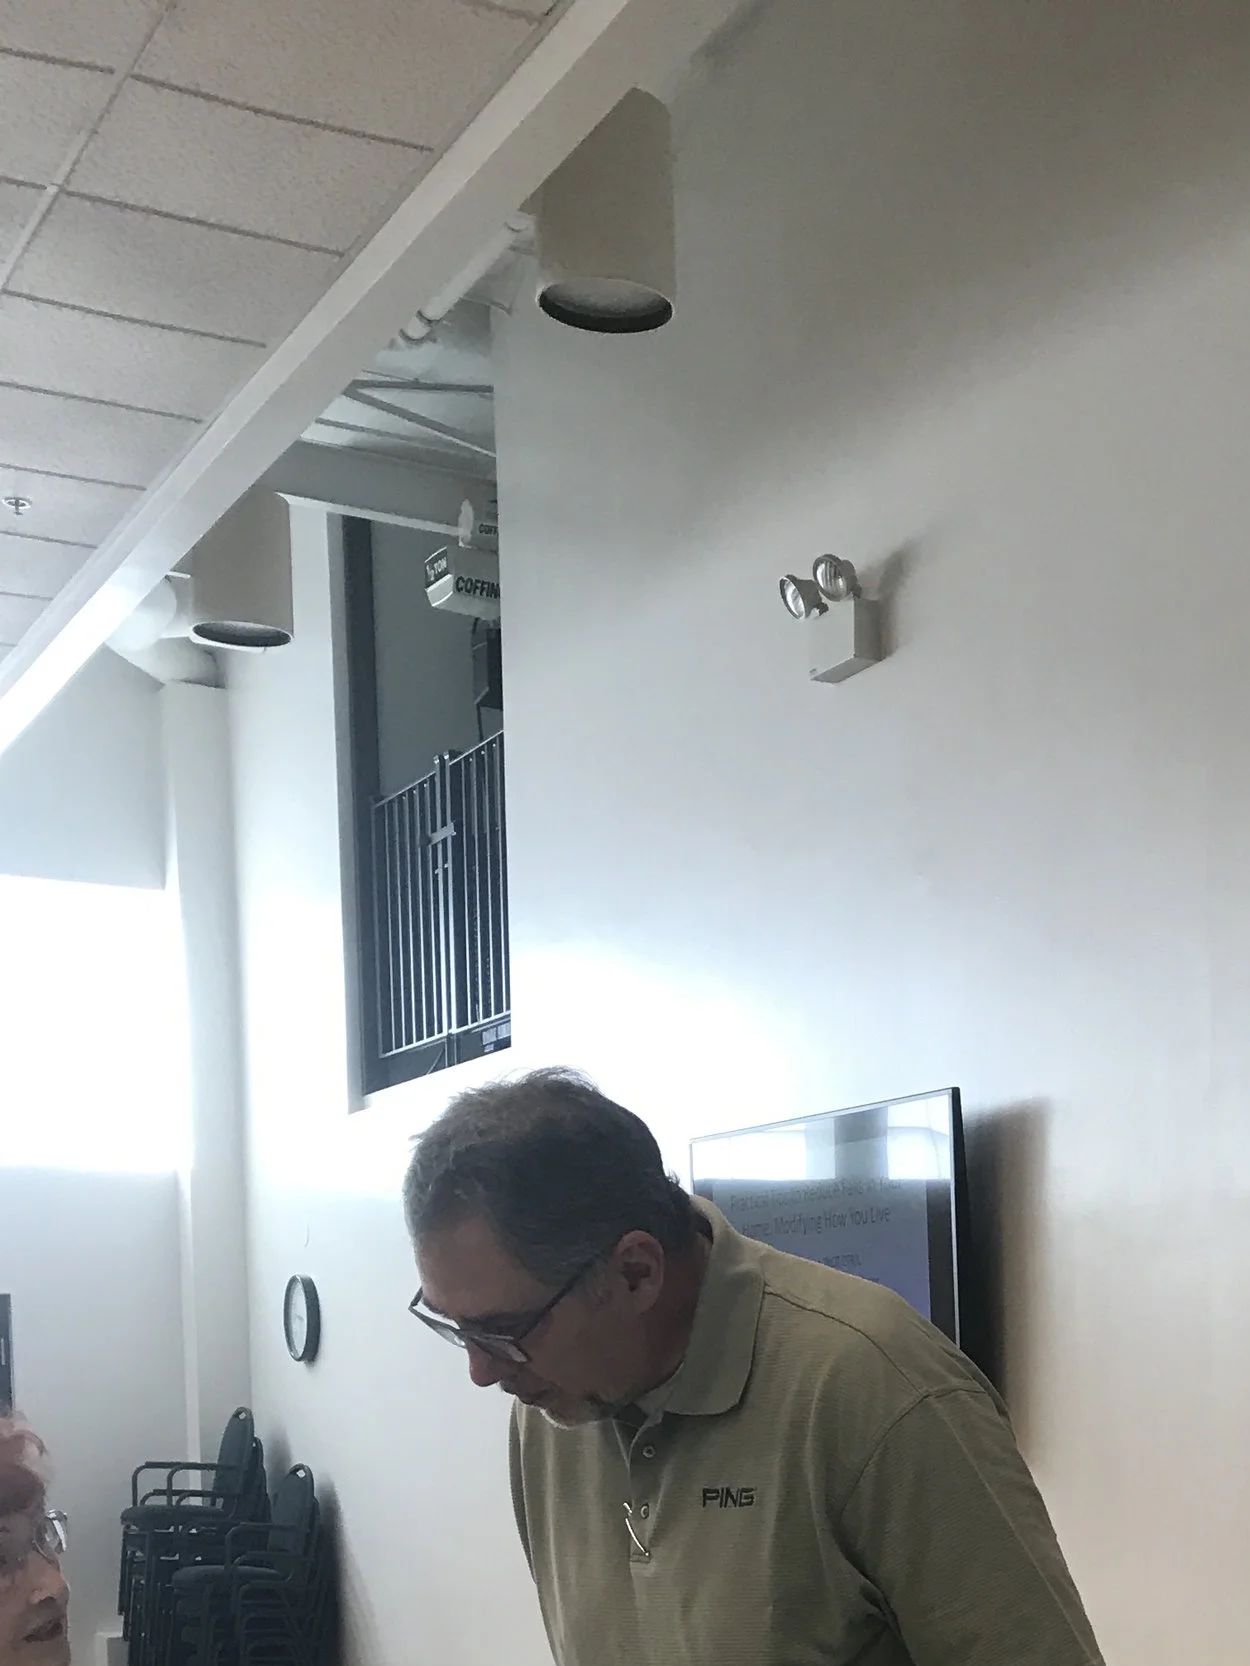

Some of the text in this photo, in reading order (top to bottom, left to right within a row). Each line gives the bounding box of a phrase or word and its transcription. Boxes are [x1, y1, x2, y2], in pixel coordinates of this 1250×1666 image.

[455, 576, 500, 599] COFFIN
[824, 1211, 846, 1228] How
[849, 1209, 868, 1226] You
[870, 1206, 891, 1223] Live
[702, 1487, 757, 1508] PING
